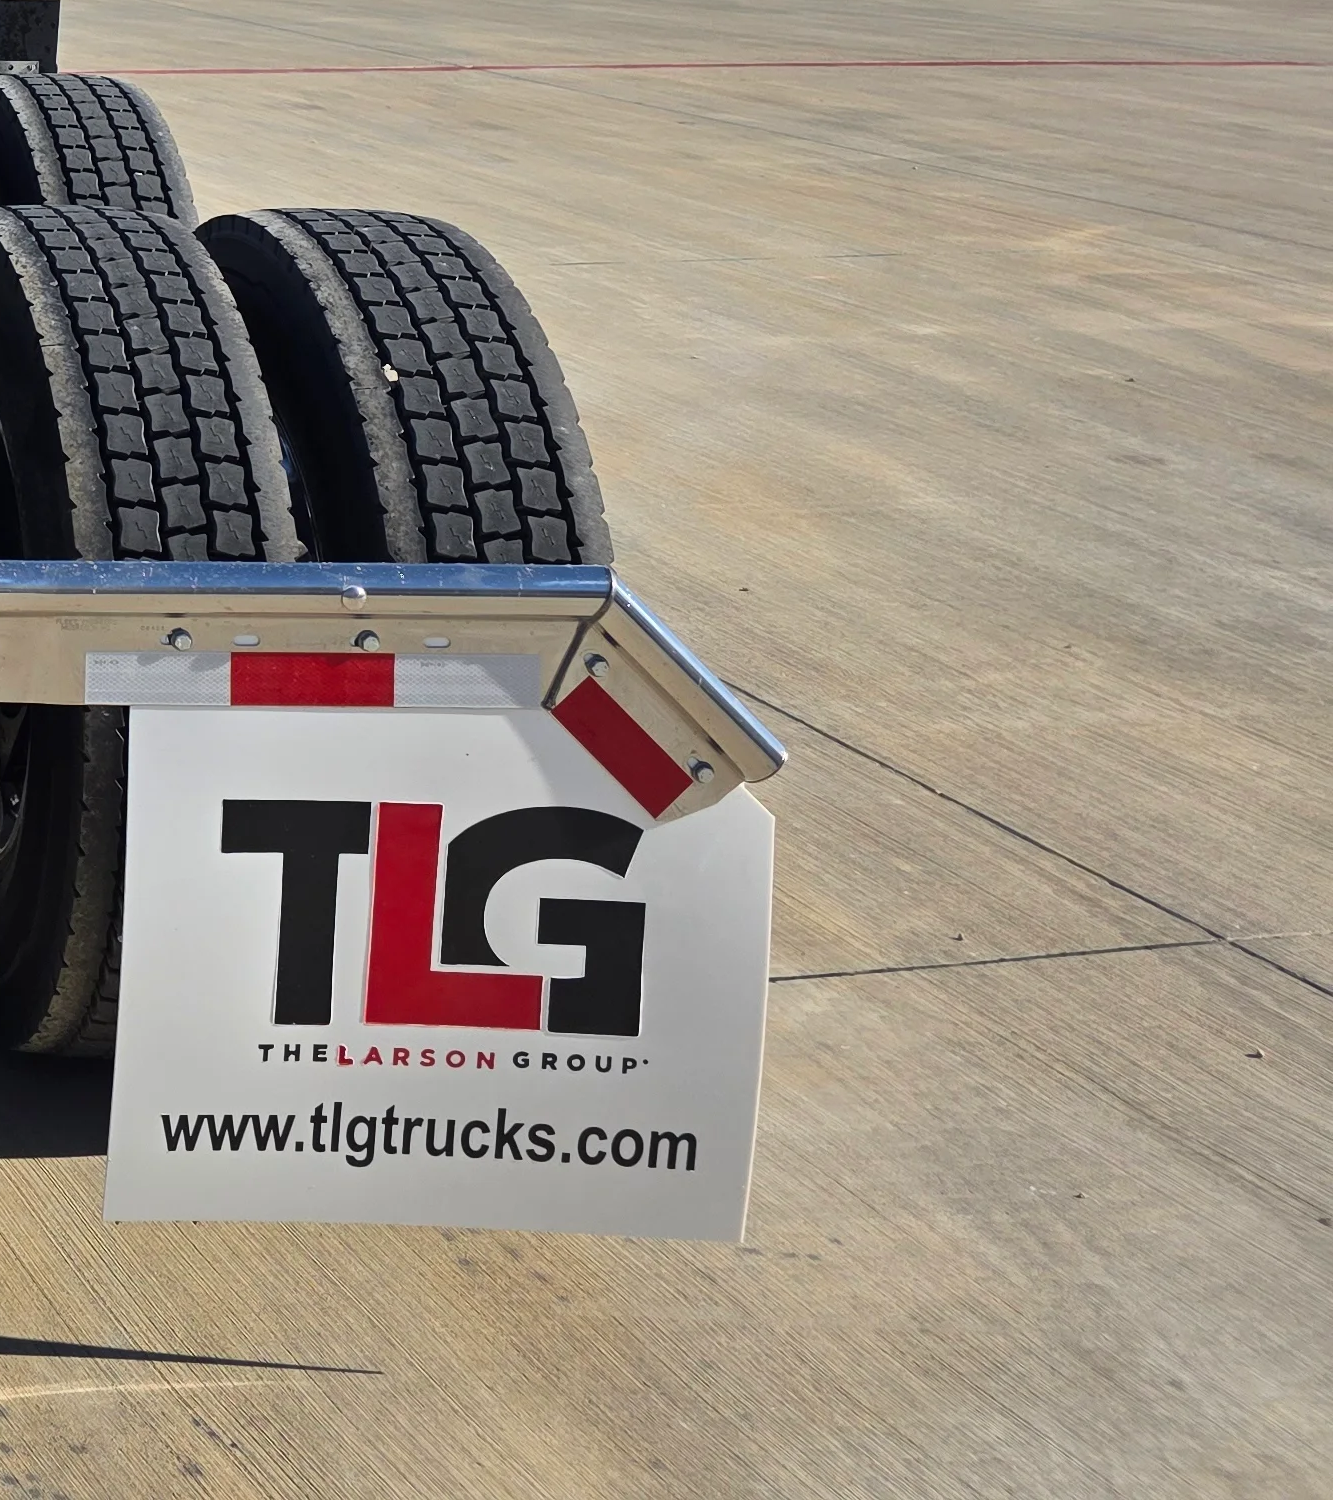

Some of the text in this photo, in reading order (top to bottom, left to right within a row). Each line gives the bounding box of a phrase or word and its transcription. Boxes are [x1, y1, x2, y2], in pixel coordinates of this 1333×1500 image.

[221, 798, 647, 1037] TLG
[512, 1050, 638, 1074] GROUP
[161, 1101, 698, 1172] www.tlgtrucks.com
